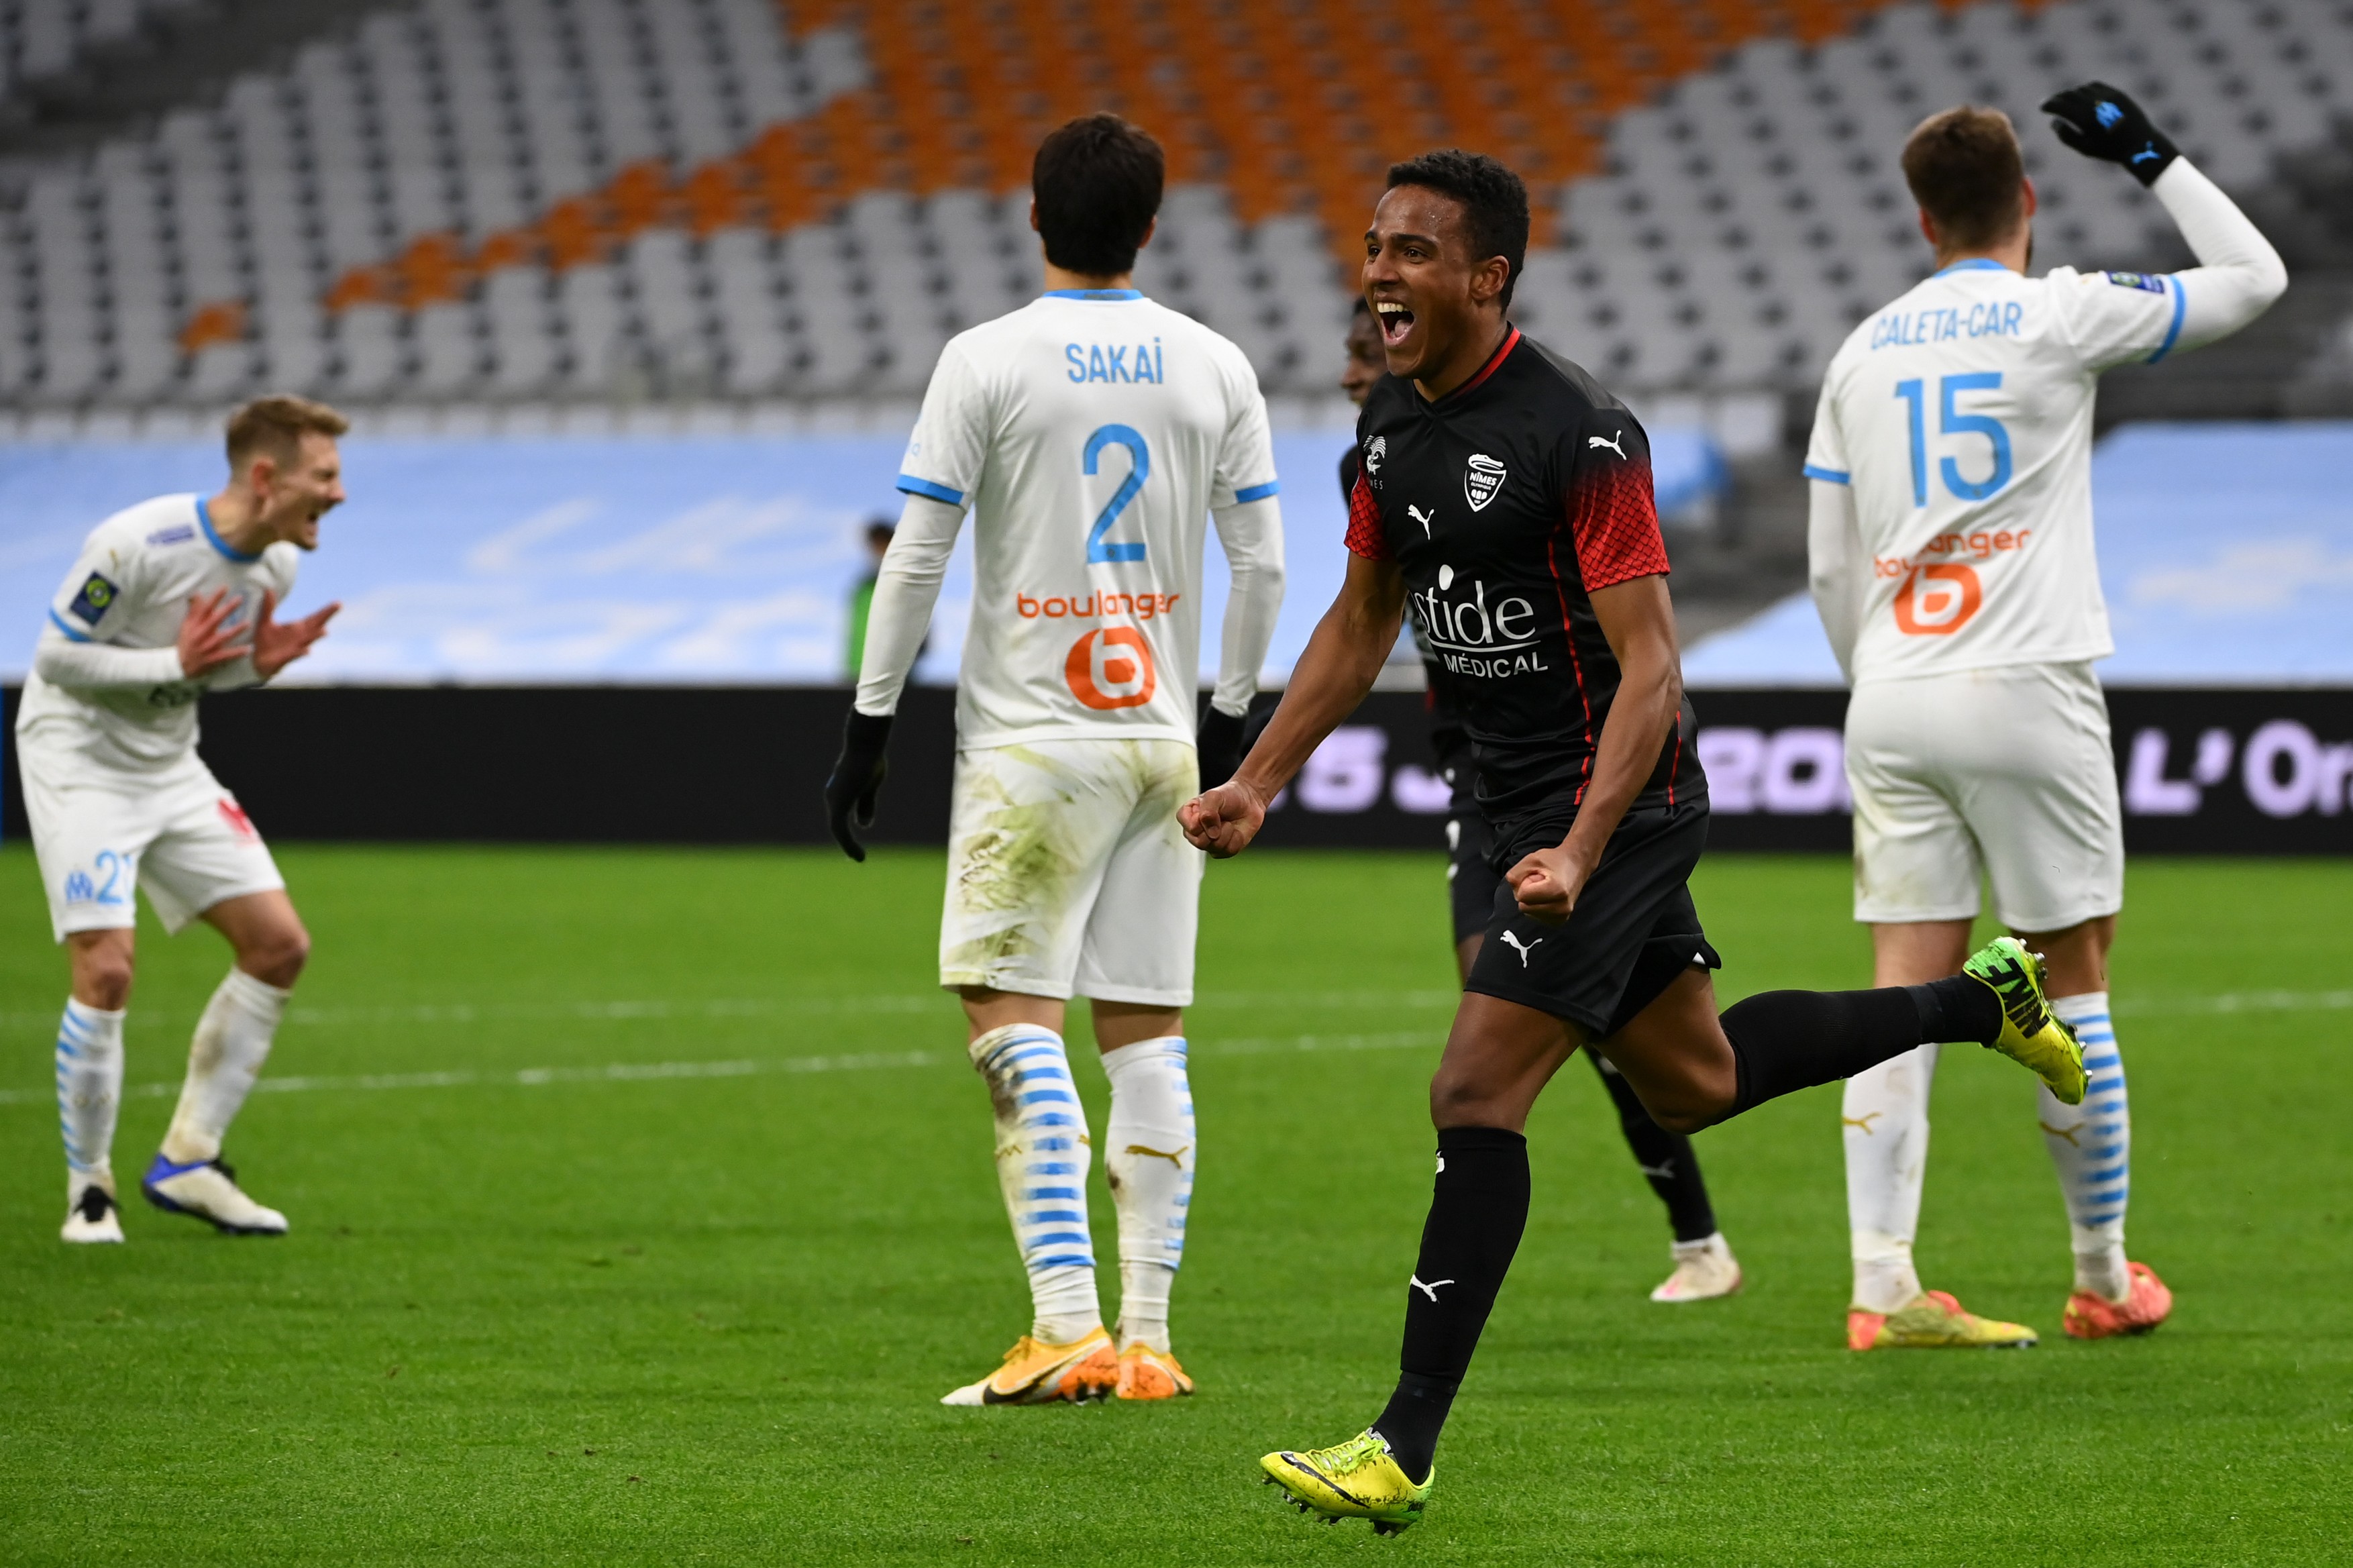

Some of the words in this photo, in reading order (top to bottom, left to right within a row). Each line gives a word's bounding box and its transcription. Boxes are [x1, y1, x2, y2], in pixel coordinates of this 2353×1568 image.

[1871, 301, 2023, 350] CALETA-CAR
[1894, 371, 2013, 508] 15
[1082, 423, 1150, 564] 2
[1469, 472, 1498, 486] NÎMES
[1017, 588, 1180, 620] boulanger
[1443, 651, 1549, 678] MÉDICAL
